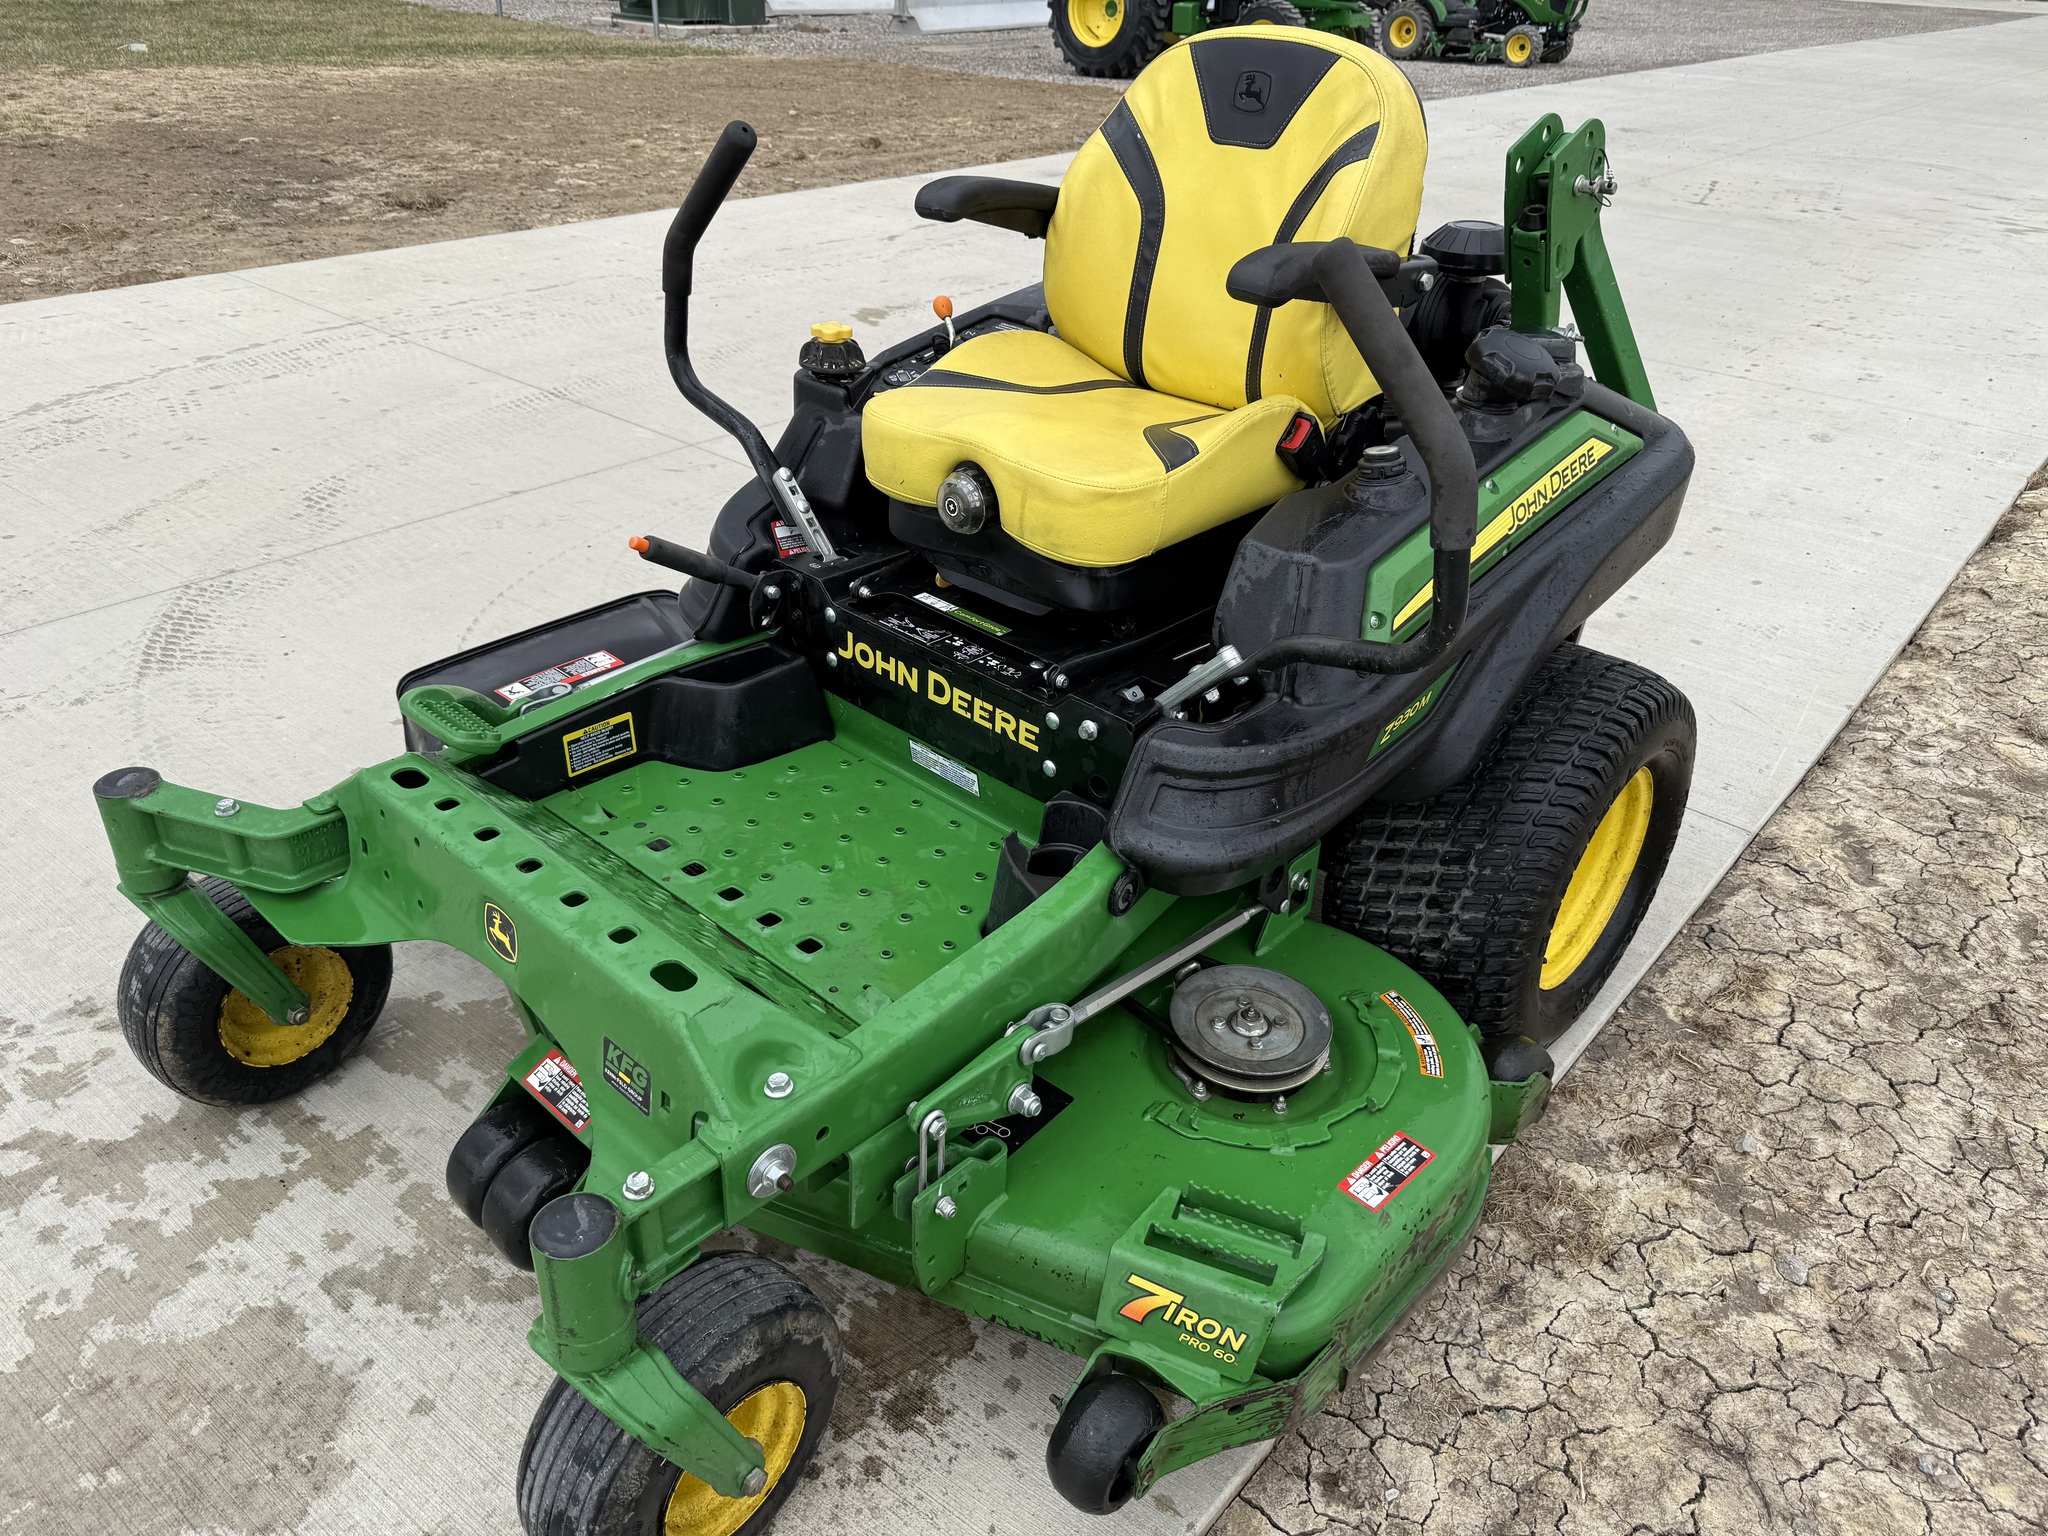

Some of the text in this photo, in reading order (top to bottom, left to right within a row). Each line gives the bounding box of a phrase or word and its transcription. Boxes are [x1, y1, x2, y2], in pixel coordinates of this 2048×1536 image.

[1507, 446, 1597, 532] JOHN DEERE
[838, 631, 1041, 753] JOHN DEERE
[588, 721, 611, 733] CAUTION
[1379, 690, 1434, 746] Z930M
[606, 1043, 648, 1088] KFG
[1379, 1134, 1402, 1153] PELIGRO
[1351, 1160, 1373, 1179] DANGER
[1118, 1272, 1247, 1353] 7 IRON
[1178, 1332, 1236, 1364] PRO 60
